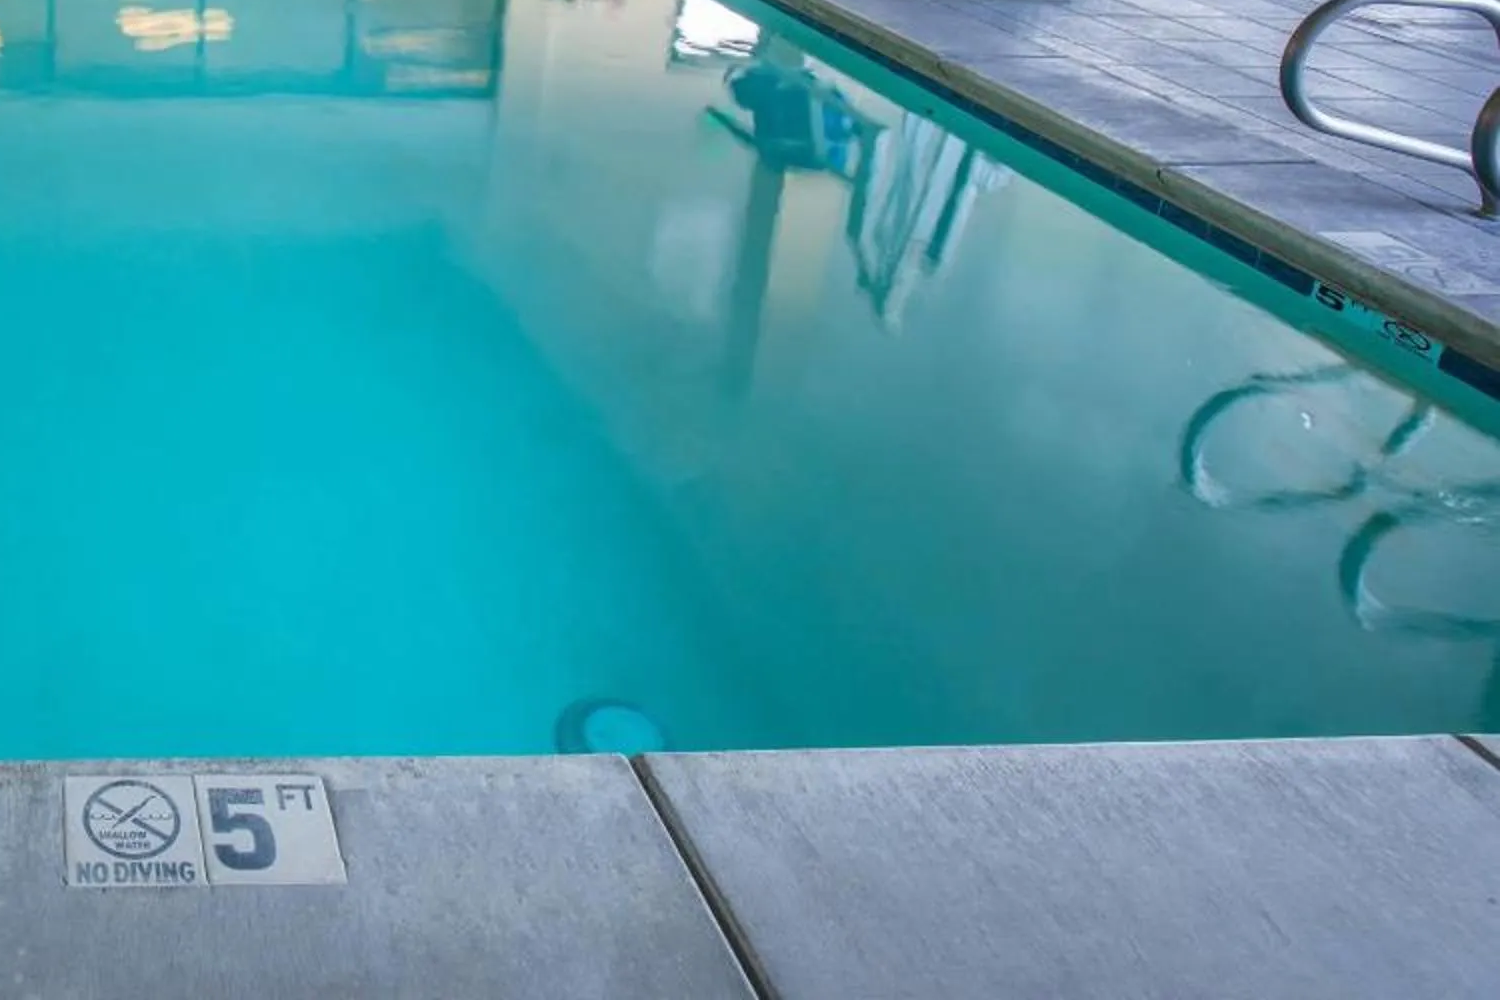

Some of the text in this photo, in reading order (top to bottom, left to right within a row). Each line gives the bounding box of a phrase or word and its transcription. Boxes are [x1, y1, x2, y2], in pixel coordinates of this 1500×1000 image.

[275, 784, 316, 811] FT
[207, 788, 277, 870] 5
[76, 861, 196, 884] NO DIVING
